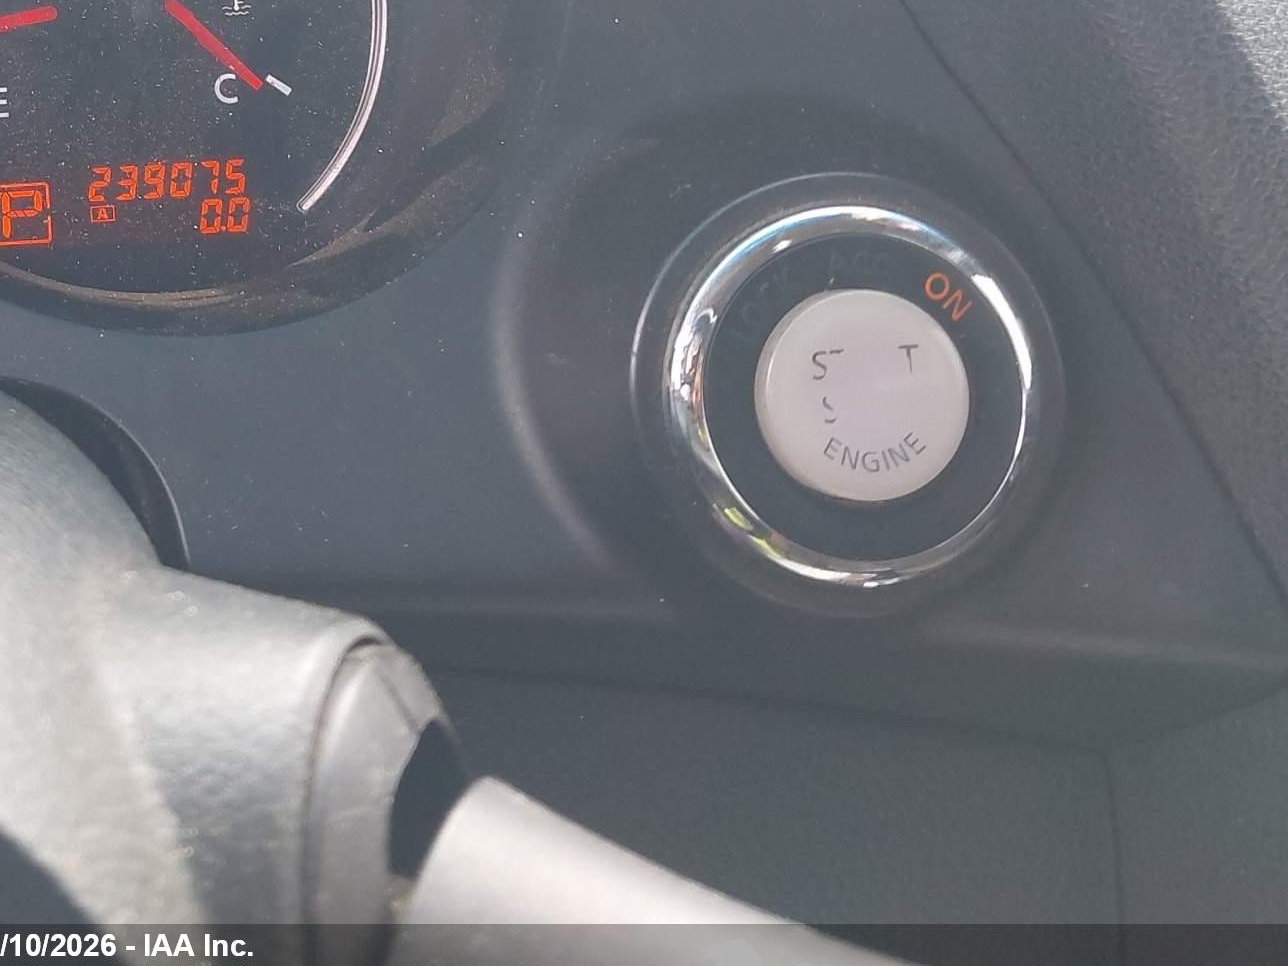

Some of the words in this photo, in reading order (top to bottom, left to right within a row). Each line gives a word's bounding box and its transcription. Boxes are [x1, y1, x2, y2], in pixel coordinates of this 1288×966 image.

[214, 74, 239, 104] C
[88, 159, 246, 202] 239075
[0, 190, 42, 238] P
[924, 272, 972, 322] ON
[823, 433, 926, 473] ENGINE
